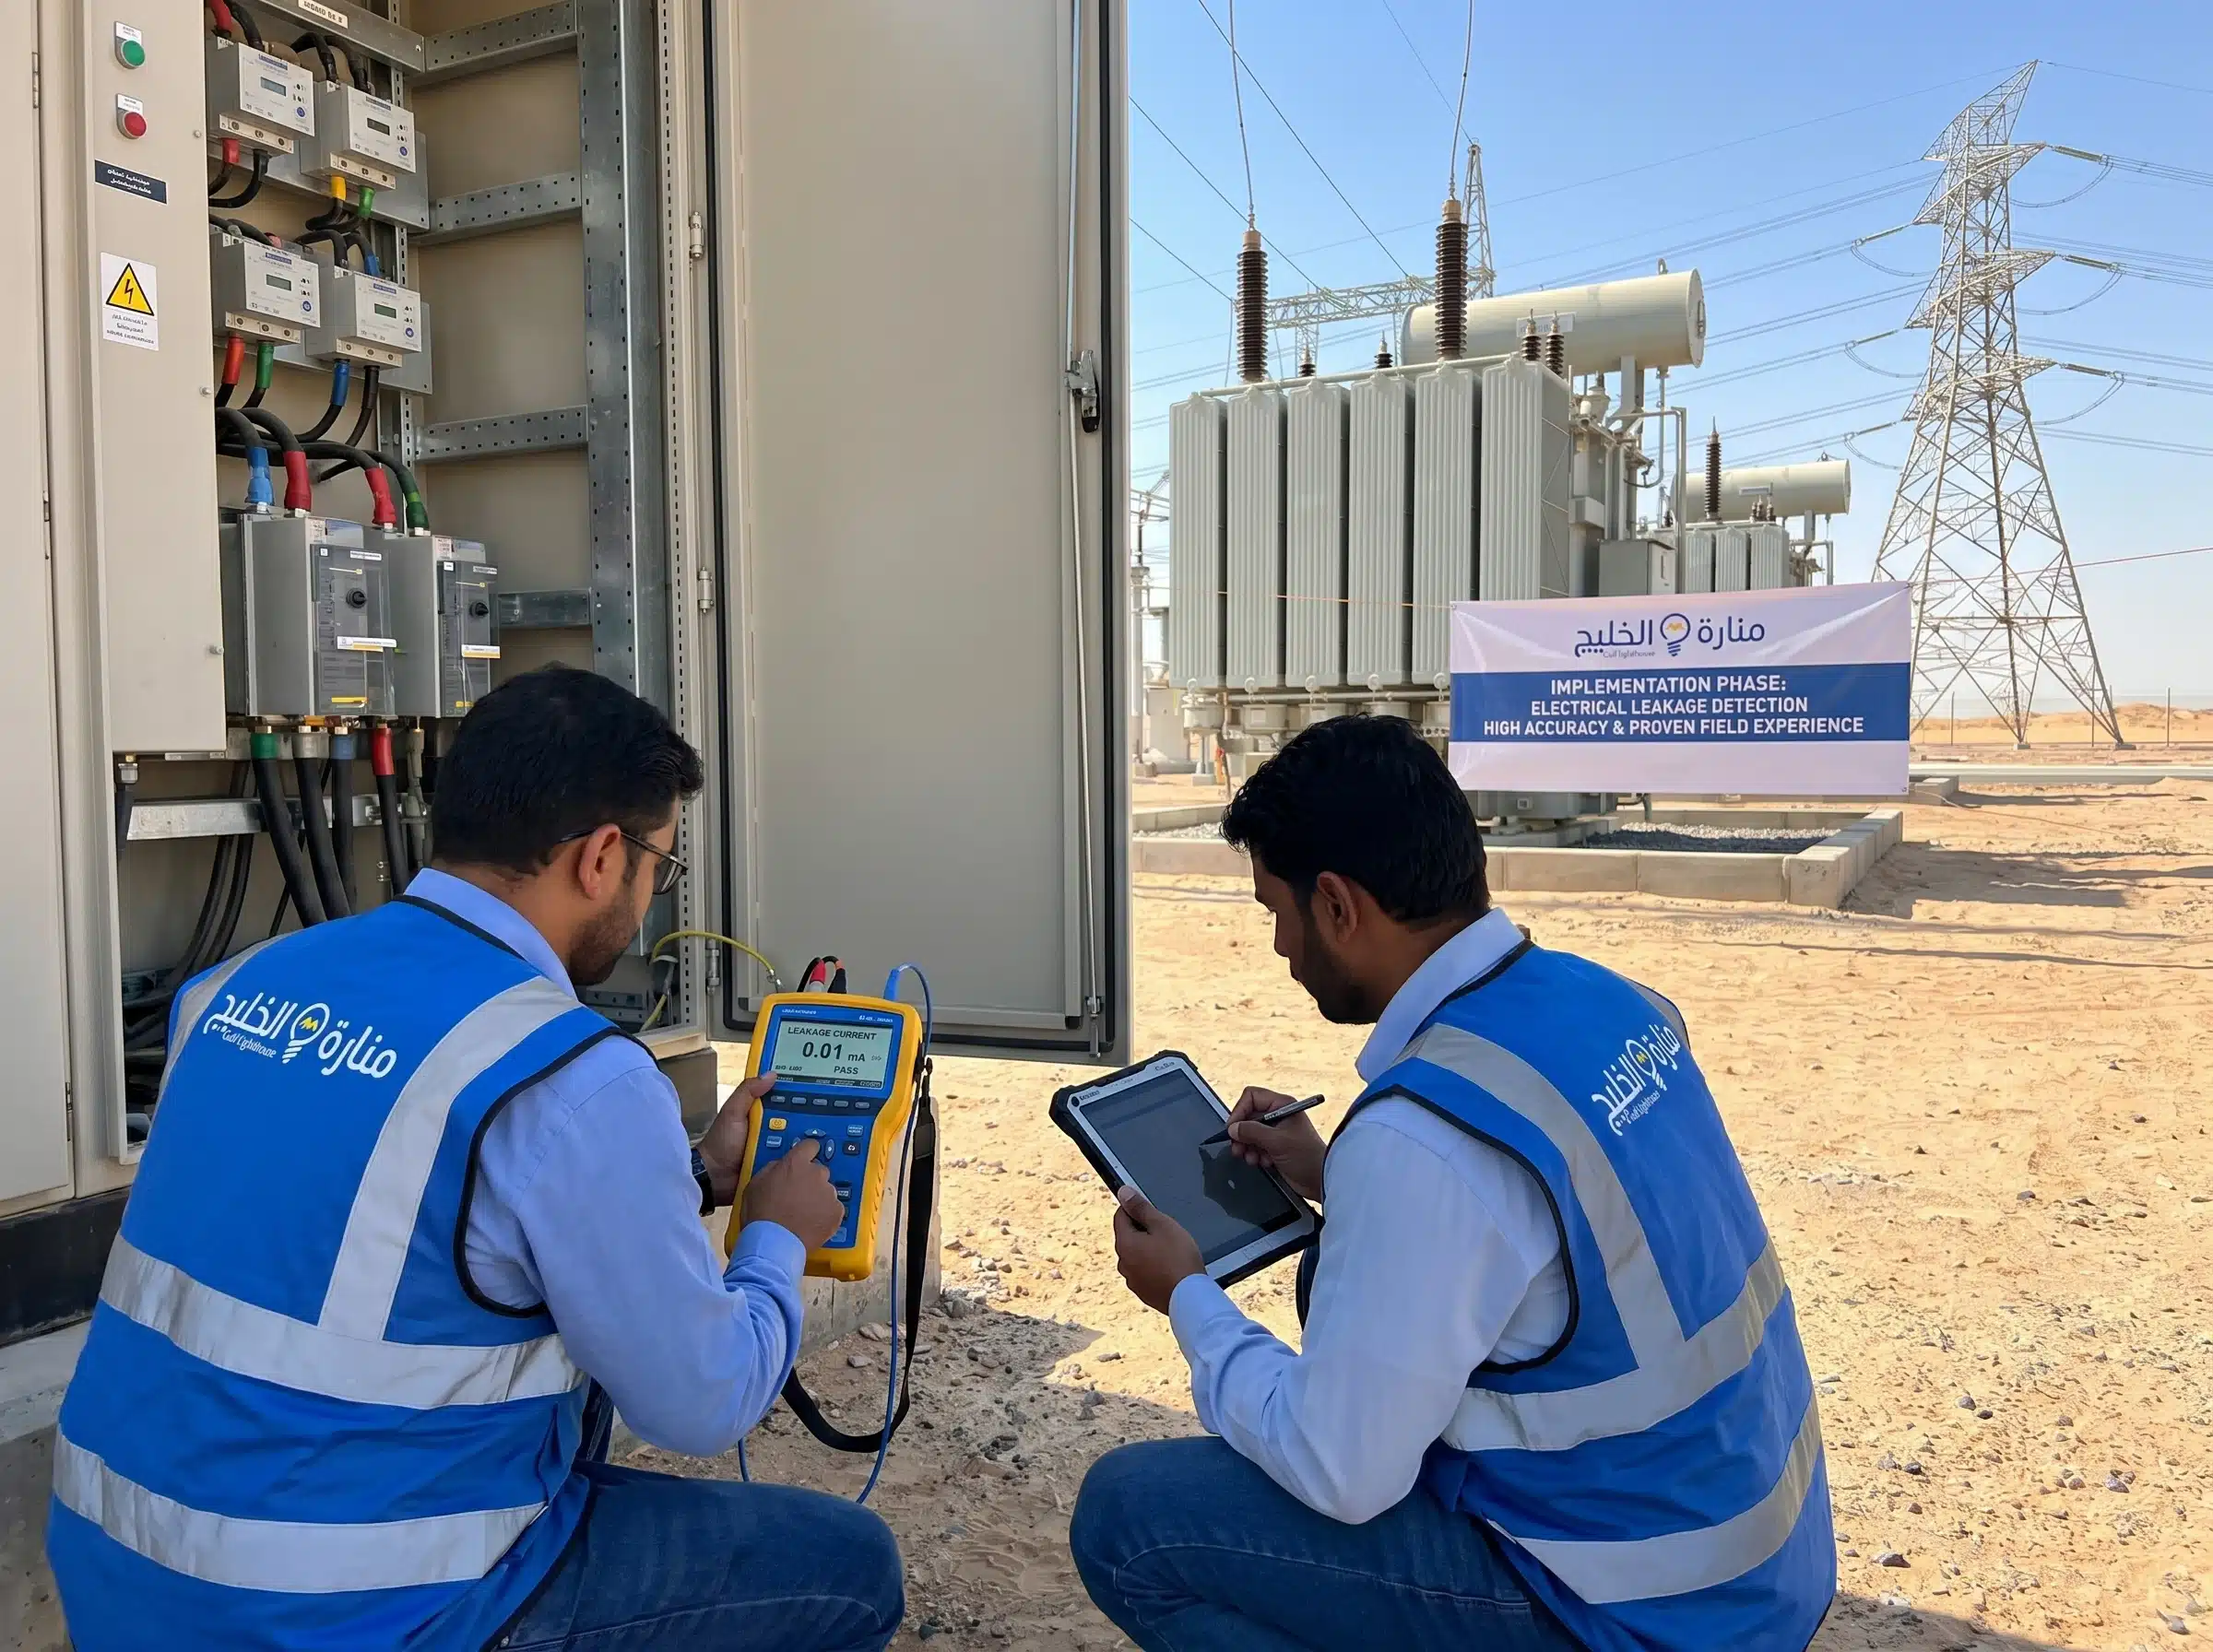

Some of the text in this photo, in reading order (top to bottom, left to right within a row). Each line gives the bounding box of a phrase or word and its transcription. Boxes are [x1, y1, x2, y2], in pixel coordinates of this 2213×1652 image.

[1698, 616, 1766, 651] منارة
[1551, 675, 1787, 695] IMPLEMENTATION PHASE:
[1531, 697, 1808, 716] ELECTRICAL LEAKAGE DETECTION
[1484, 717, 1864, 736] HIGH ACCURACY & PROVEN FIELD EXPERIENCE
[203, 992, 397, 1079] منارة الخليج
[787, 1026, 877, 1040] LEAKAGE CURRENT
[802, 1041, 843, 1060] 0.01
[847, 1053, 866, 1062] mA
[834, 1066, 859, 1075] PASS
